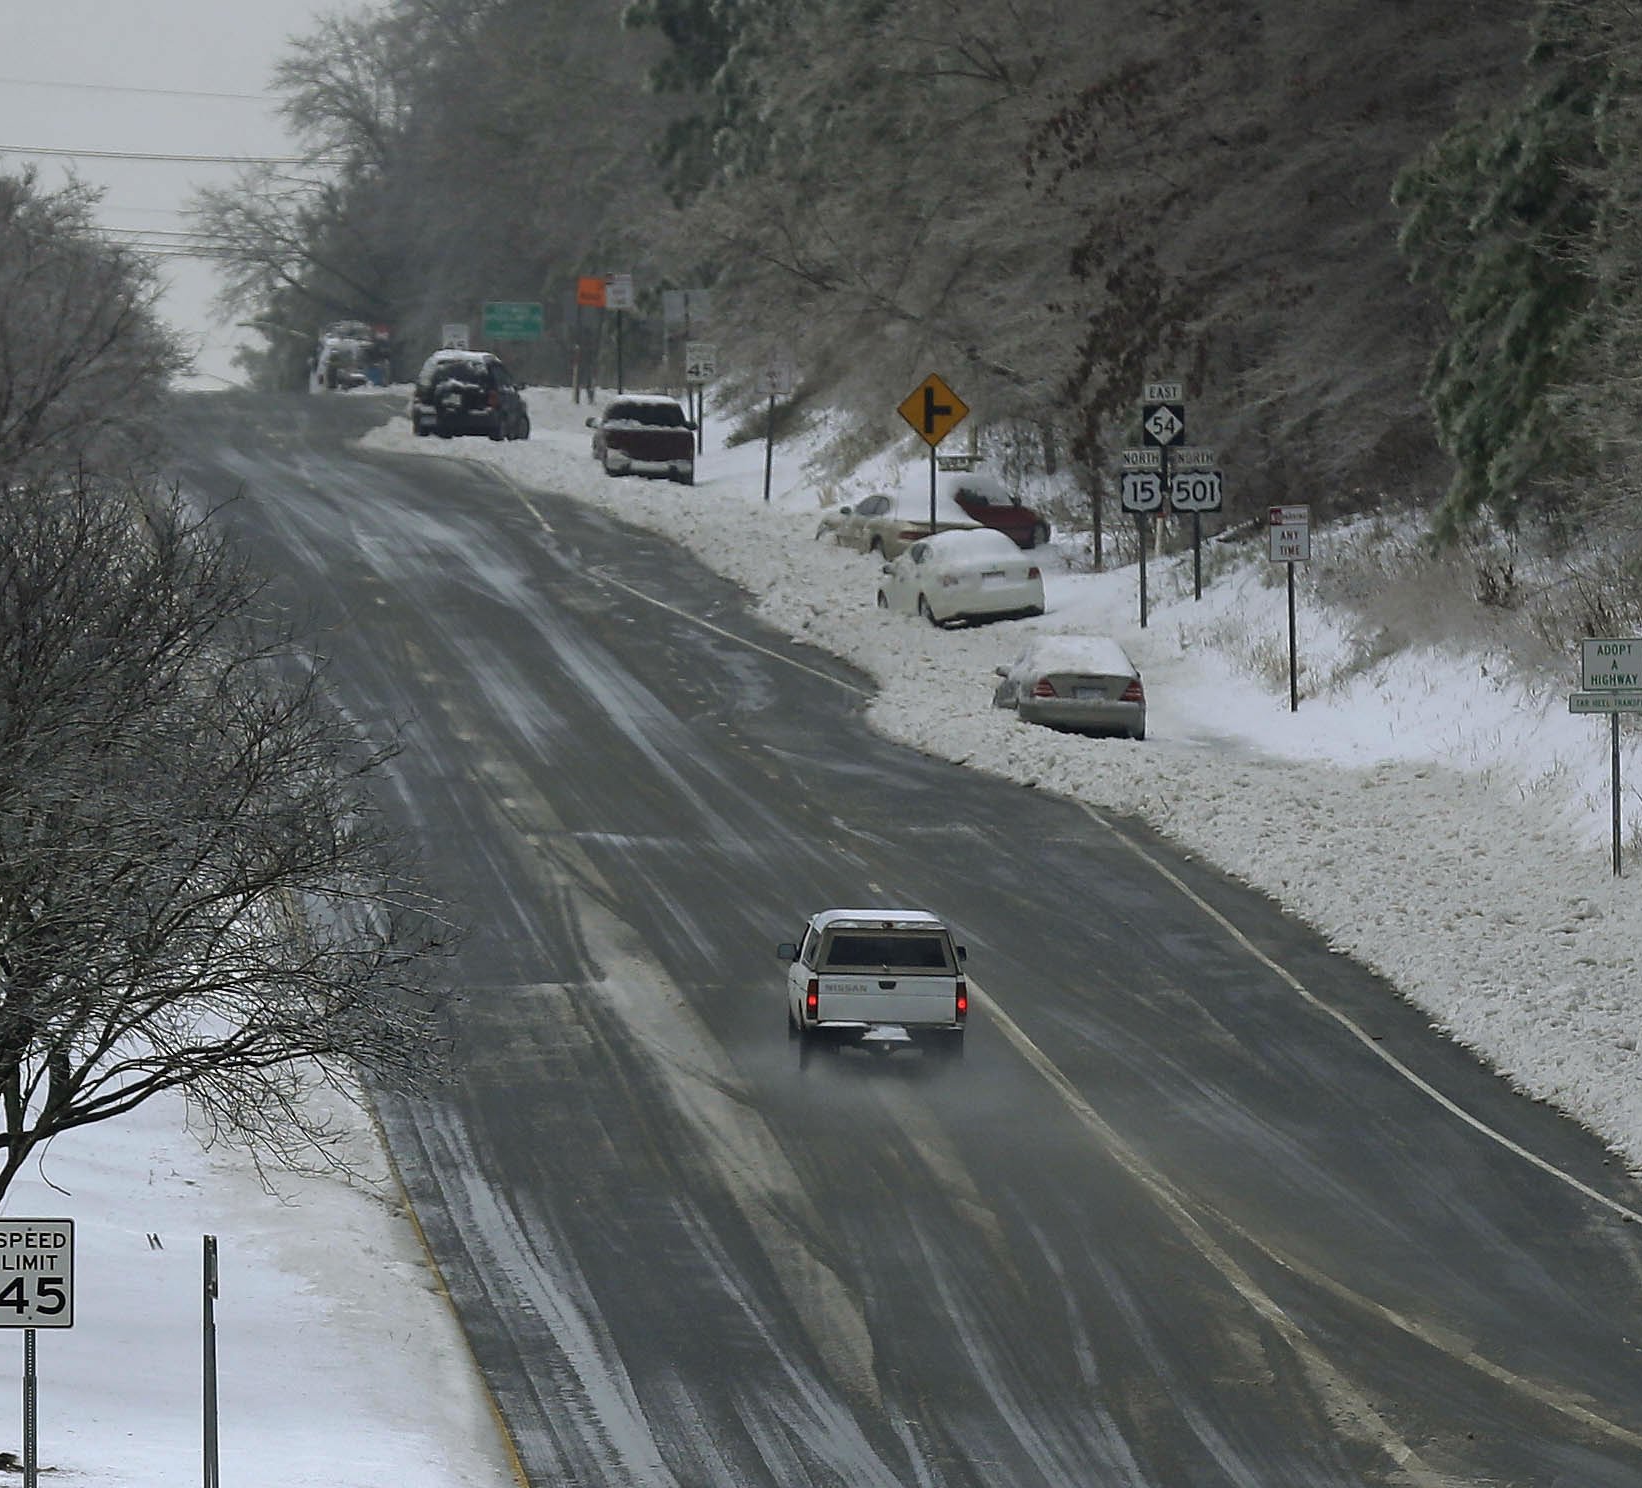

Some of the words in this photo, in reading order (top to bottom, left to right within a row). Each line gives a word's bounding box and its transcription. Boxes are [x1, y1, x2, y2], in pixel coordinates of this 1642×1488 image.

[687, 363, 714, 377] 45
[1149, 386, 1178, 399] EAST
[1153, 416, 1176, 434] 54
[1123, 452, 1159, 464] NORTH
[1132, 481, 1155, 502] 15
[1176, 481, 1215, 502] 501
[1281, 531, 1299, 540] ANY
[1280, 545, 1300, 556] TIME
[1597, 644, 1632, 656] ADOPT
[1611, 659, 1619, 671] A
[1590, 674, 1638, 687] HIGHWAY
[824, 983, 868, 993] NISSAN
[2, 1254, 58, 1270] LIMIT
